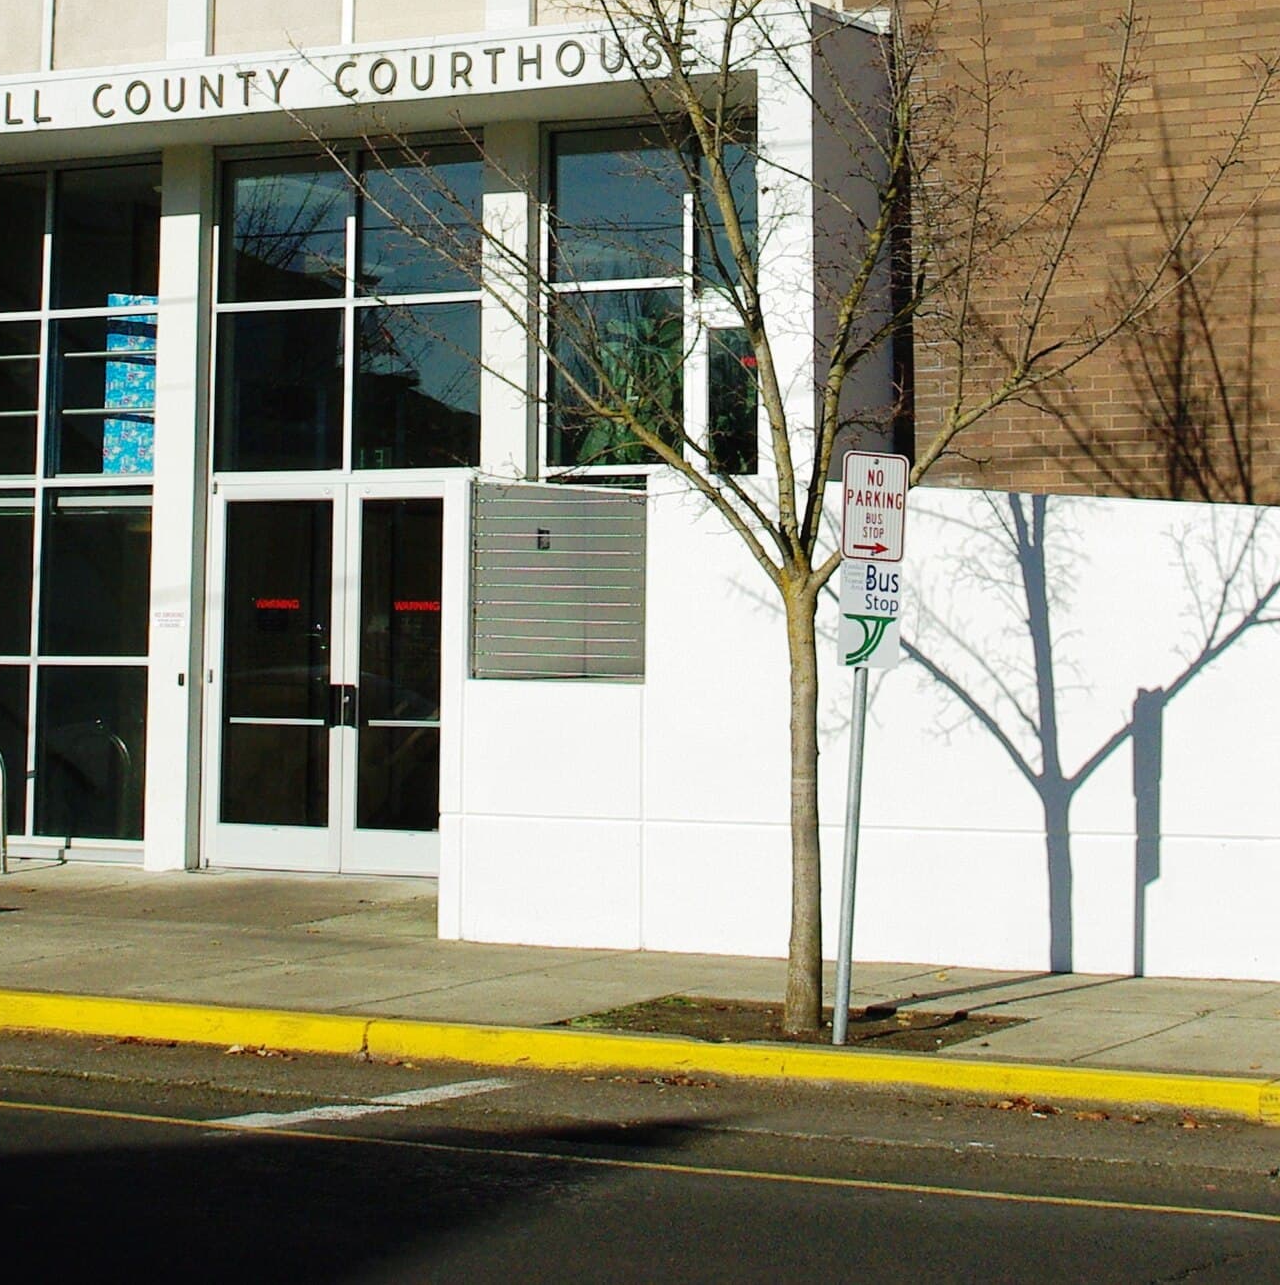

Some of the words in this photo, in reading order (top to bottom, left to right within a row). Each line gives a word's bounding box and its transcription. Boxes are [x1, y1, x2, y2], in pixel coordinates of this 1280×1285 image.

[92, 68, 290, 119] COUNTY
[334, 29, 698, 98] COURTHOUSE
[867, 469, 884, 487] NO
[846, 489, 903, 510] PARKING
[865, 512, 883, 525] BUS
[863, 526, 885, 539] STOP
[866, 564, 899, 593] Bus
[256, 598, 300, 610] WARNING
[394, 601, 441, 611] WARNING
[865, 593, 899, 615] Stop
